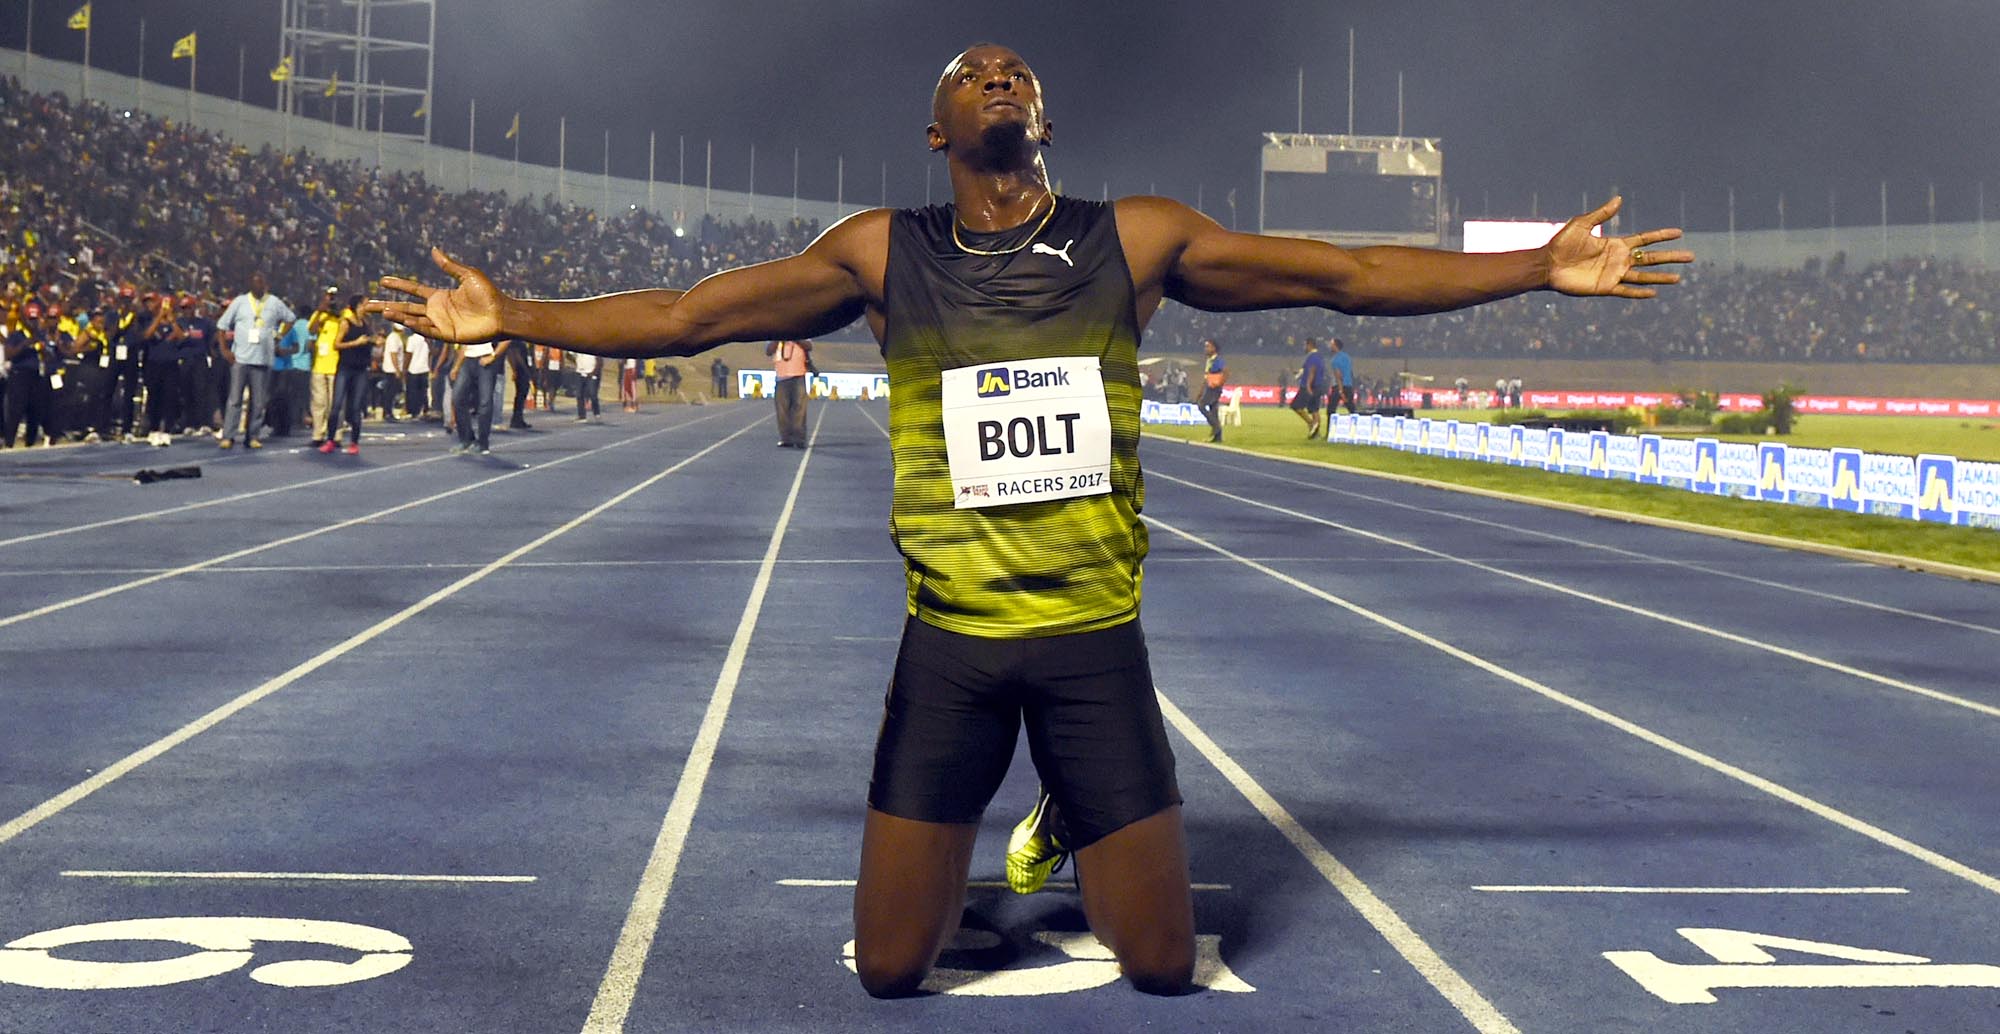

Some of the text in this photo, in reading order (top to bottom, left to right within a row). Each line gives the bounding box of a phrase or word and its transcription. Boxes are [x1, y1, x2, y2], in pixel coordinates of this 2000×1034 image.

[1013, 366, 1070, 390] Bank
[977, 413, 1081, 461] BOLT
[1719, 447, 1757, 463] JAMAICA
[1787, 452, 1829, 469] JAMAICA
[1864, 458, 1913, 478] JAMAICA
[997, 476, 1064, 497] RACERS
[1069, 472, 1103, 490] 2017
[1787, 470, 1830, 489] NATIONAL
[1863, 478, 1914, 500] NATIONAL
